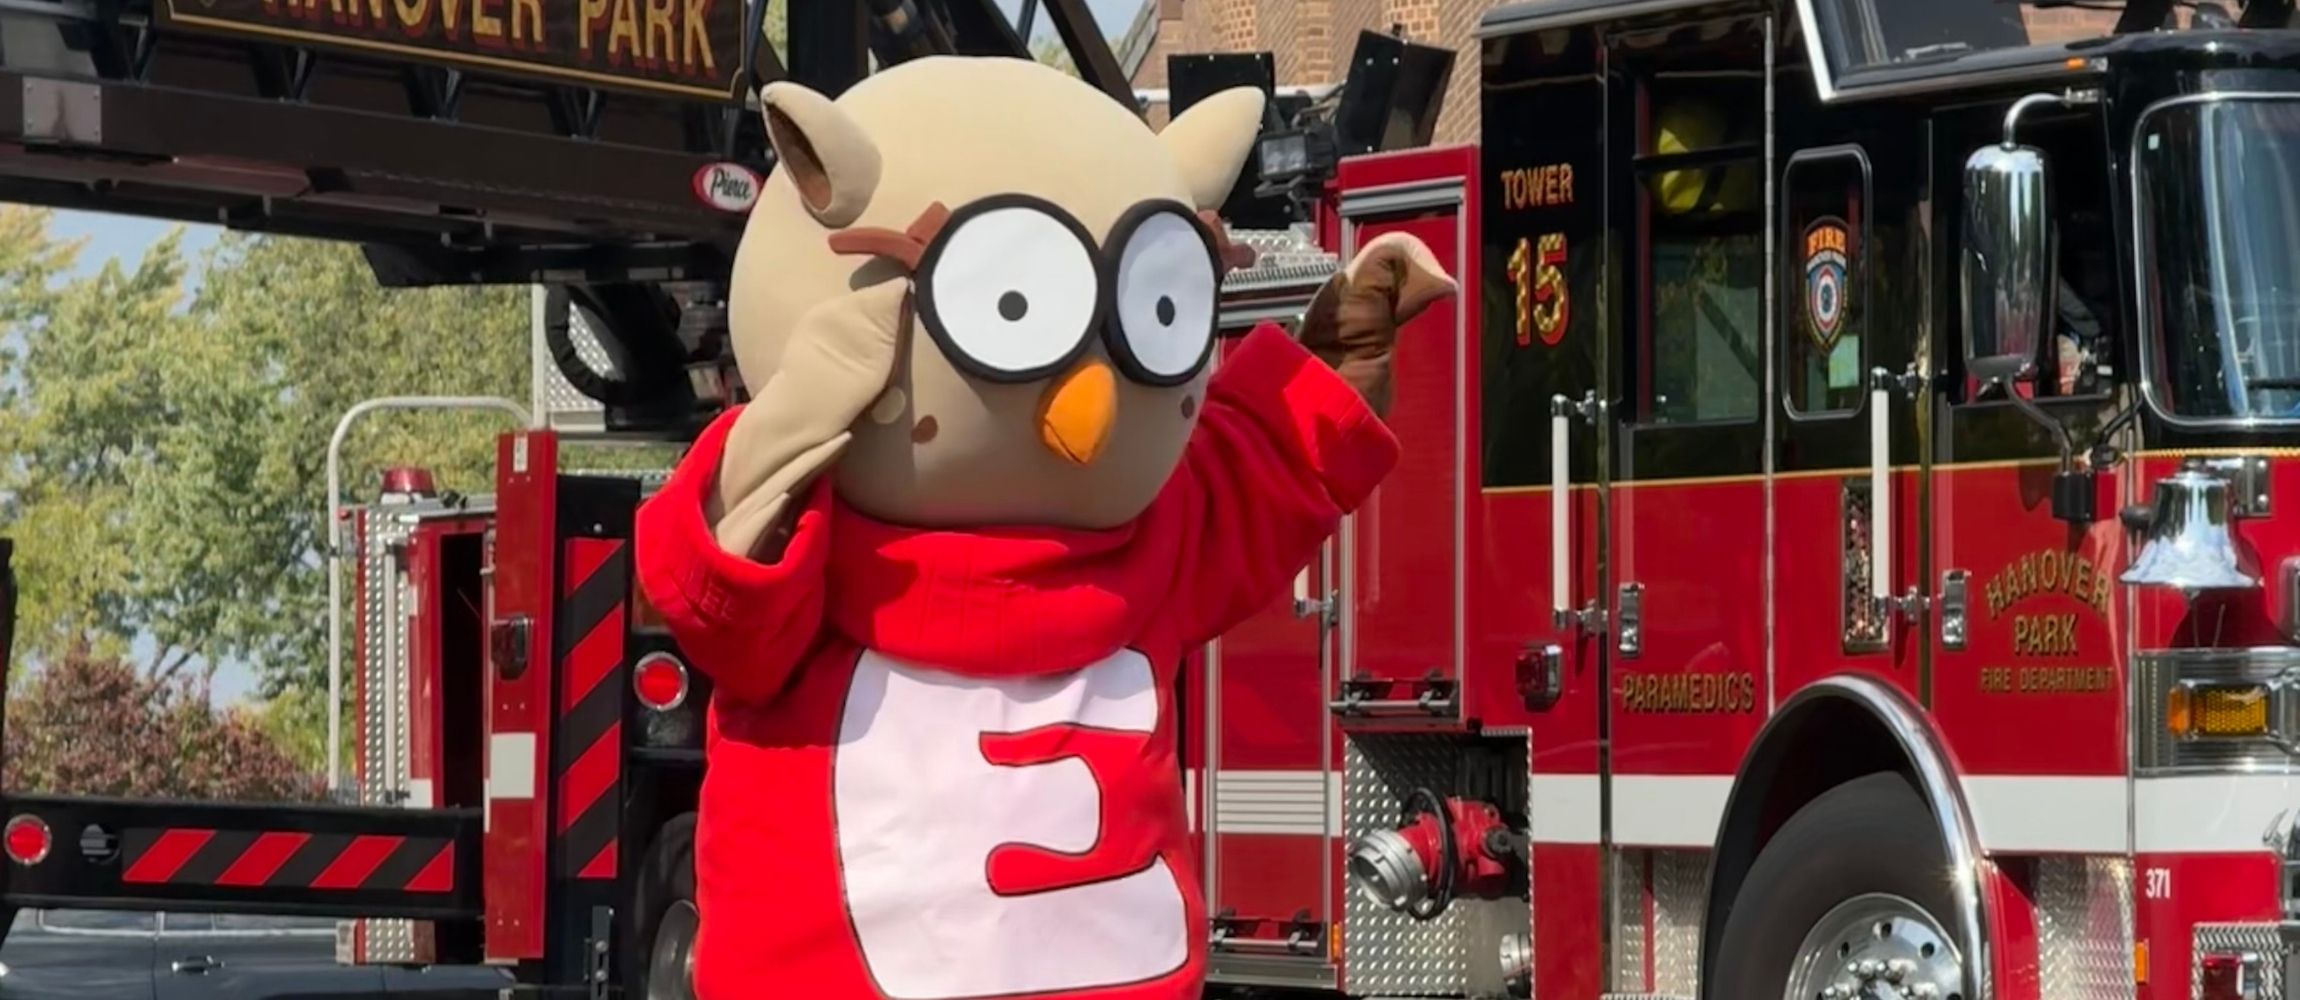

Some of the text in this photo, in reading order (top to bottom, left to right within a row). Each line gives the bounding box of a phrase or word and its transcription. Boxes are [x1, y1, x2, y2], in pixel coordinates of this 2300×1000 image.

[710, 166, 752, 201] Pierce
[1500, 162, 1573, 210] TOWER
[1807, 225, 1846, 257] FIRE
[1506, 231, 1570, 346] 15
[1985, 548, 2111, 620] HANOVER
[2015, 614, 2078, 656] PARK
[1623, 672, 1755, 713] PARAMEDICS
[1981, 667, 2114, 691] FIRE DEPARTMENT
[832, 646, 1190, 1000] E
[2145, 867, 2171, 899] 371
